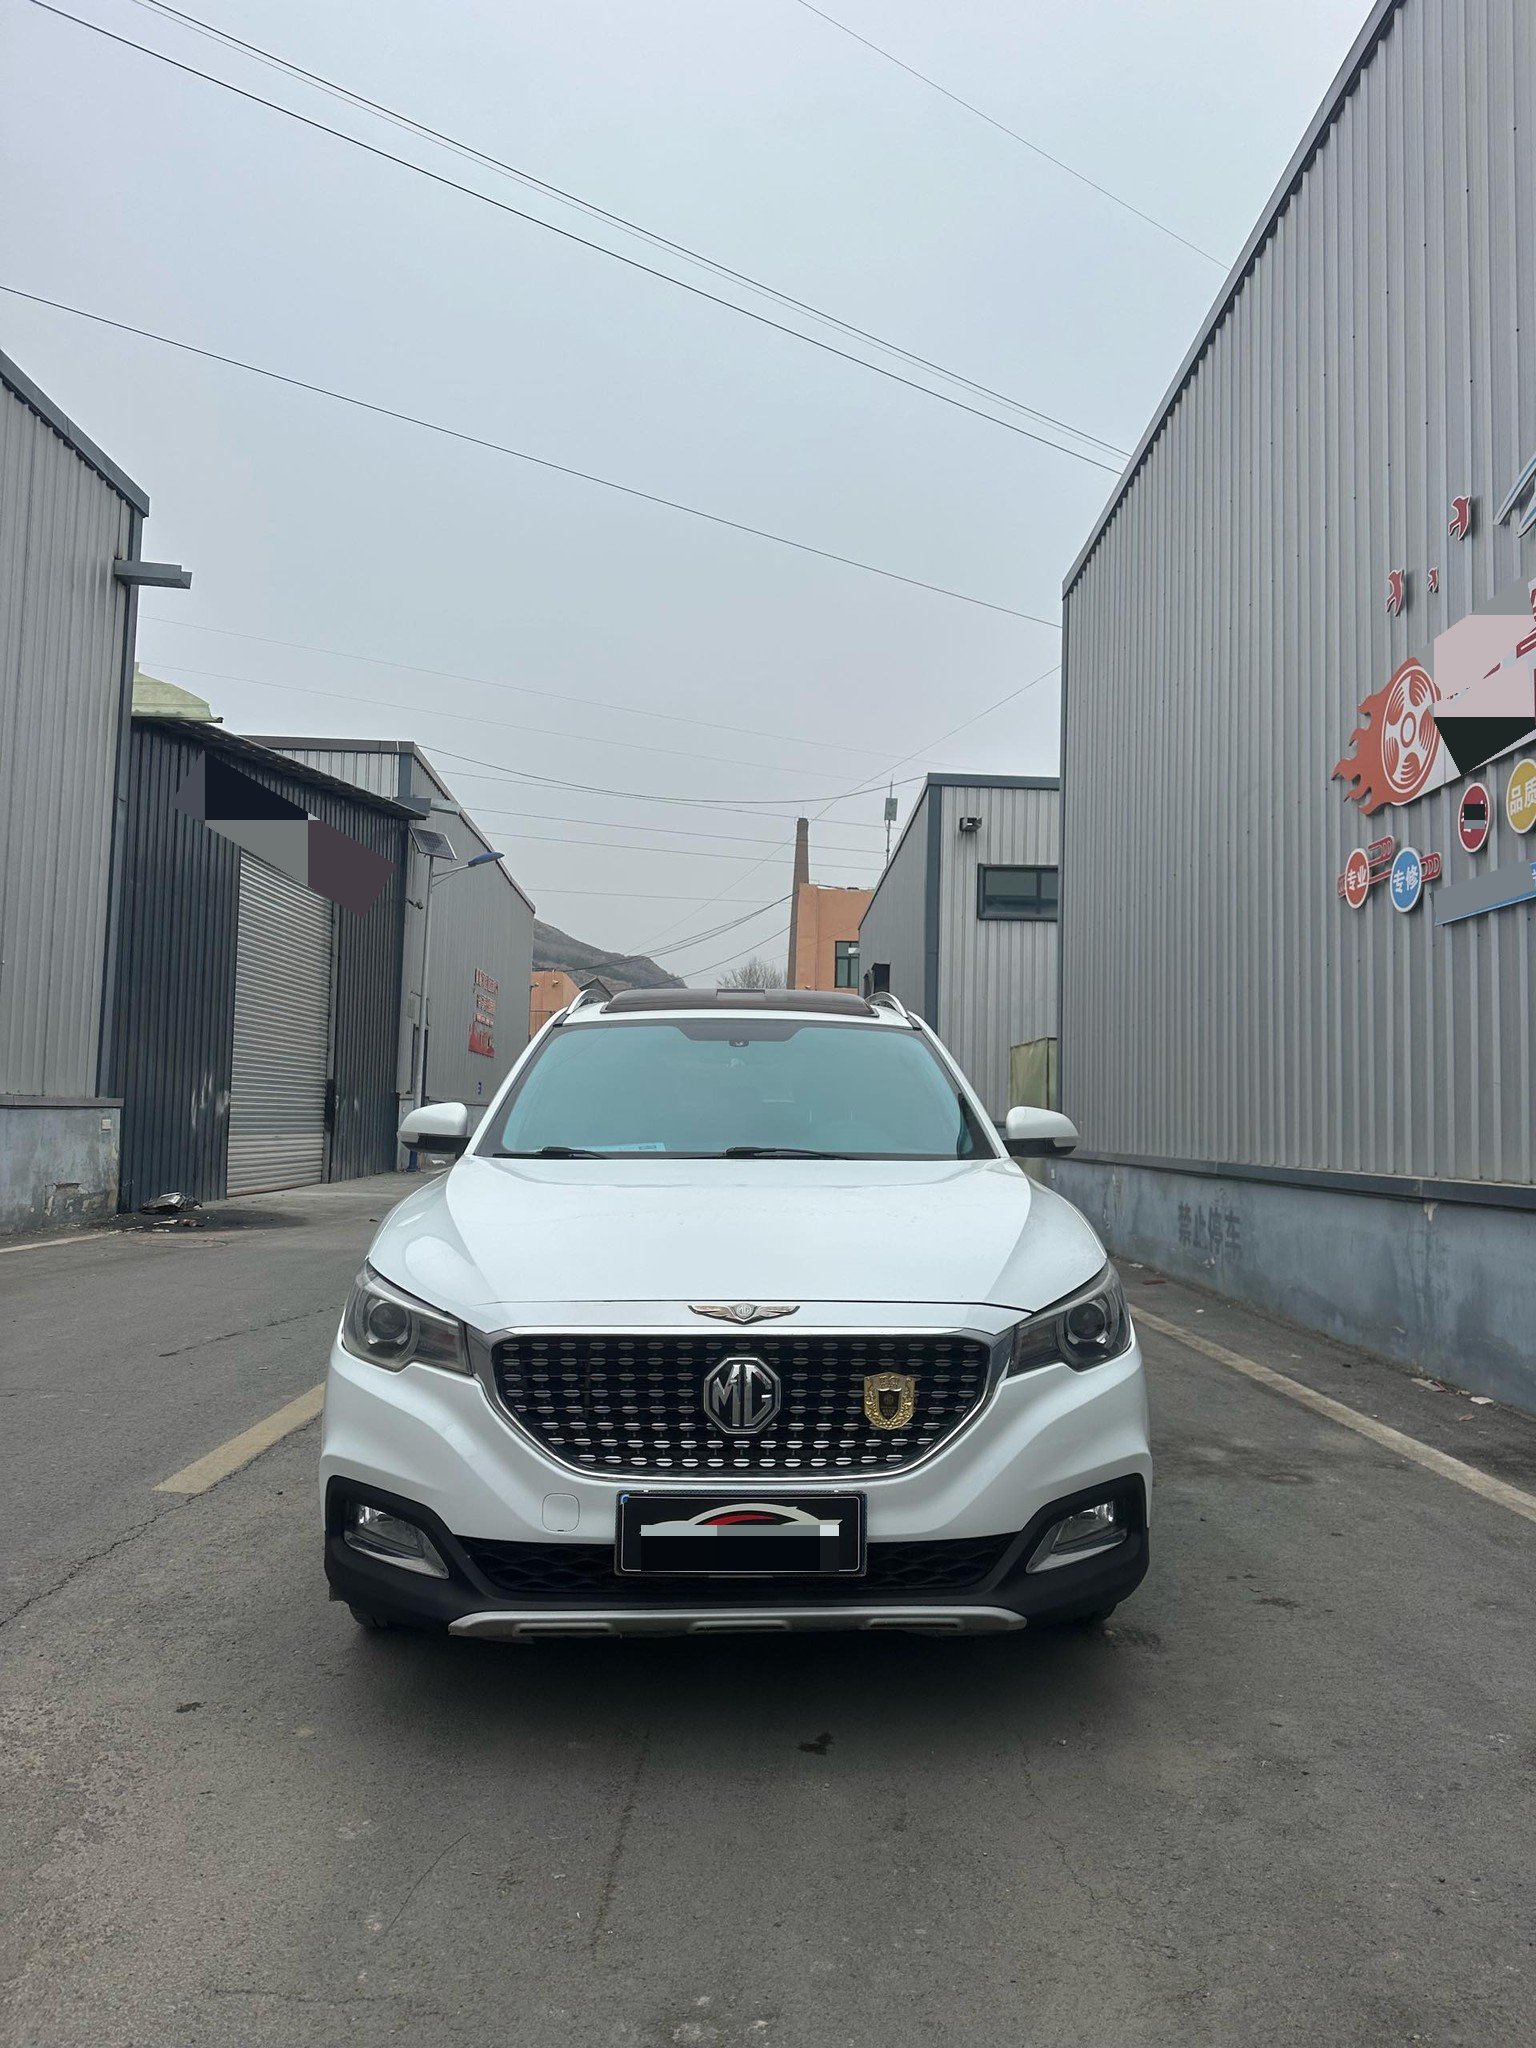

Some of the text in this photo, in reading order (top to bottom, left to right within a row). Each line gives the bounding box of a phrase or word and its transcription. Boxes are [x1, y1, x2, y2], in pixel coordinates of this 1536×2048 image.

[1347, 865, 1368, 891] 专业
[1393, 865, 1419, 894] 专修
[1178, 1201, 1241, 1260] 禁止停车
[711, 1364, 772, 1427] MG
